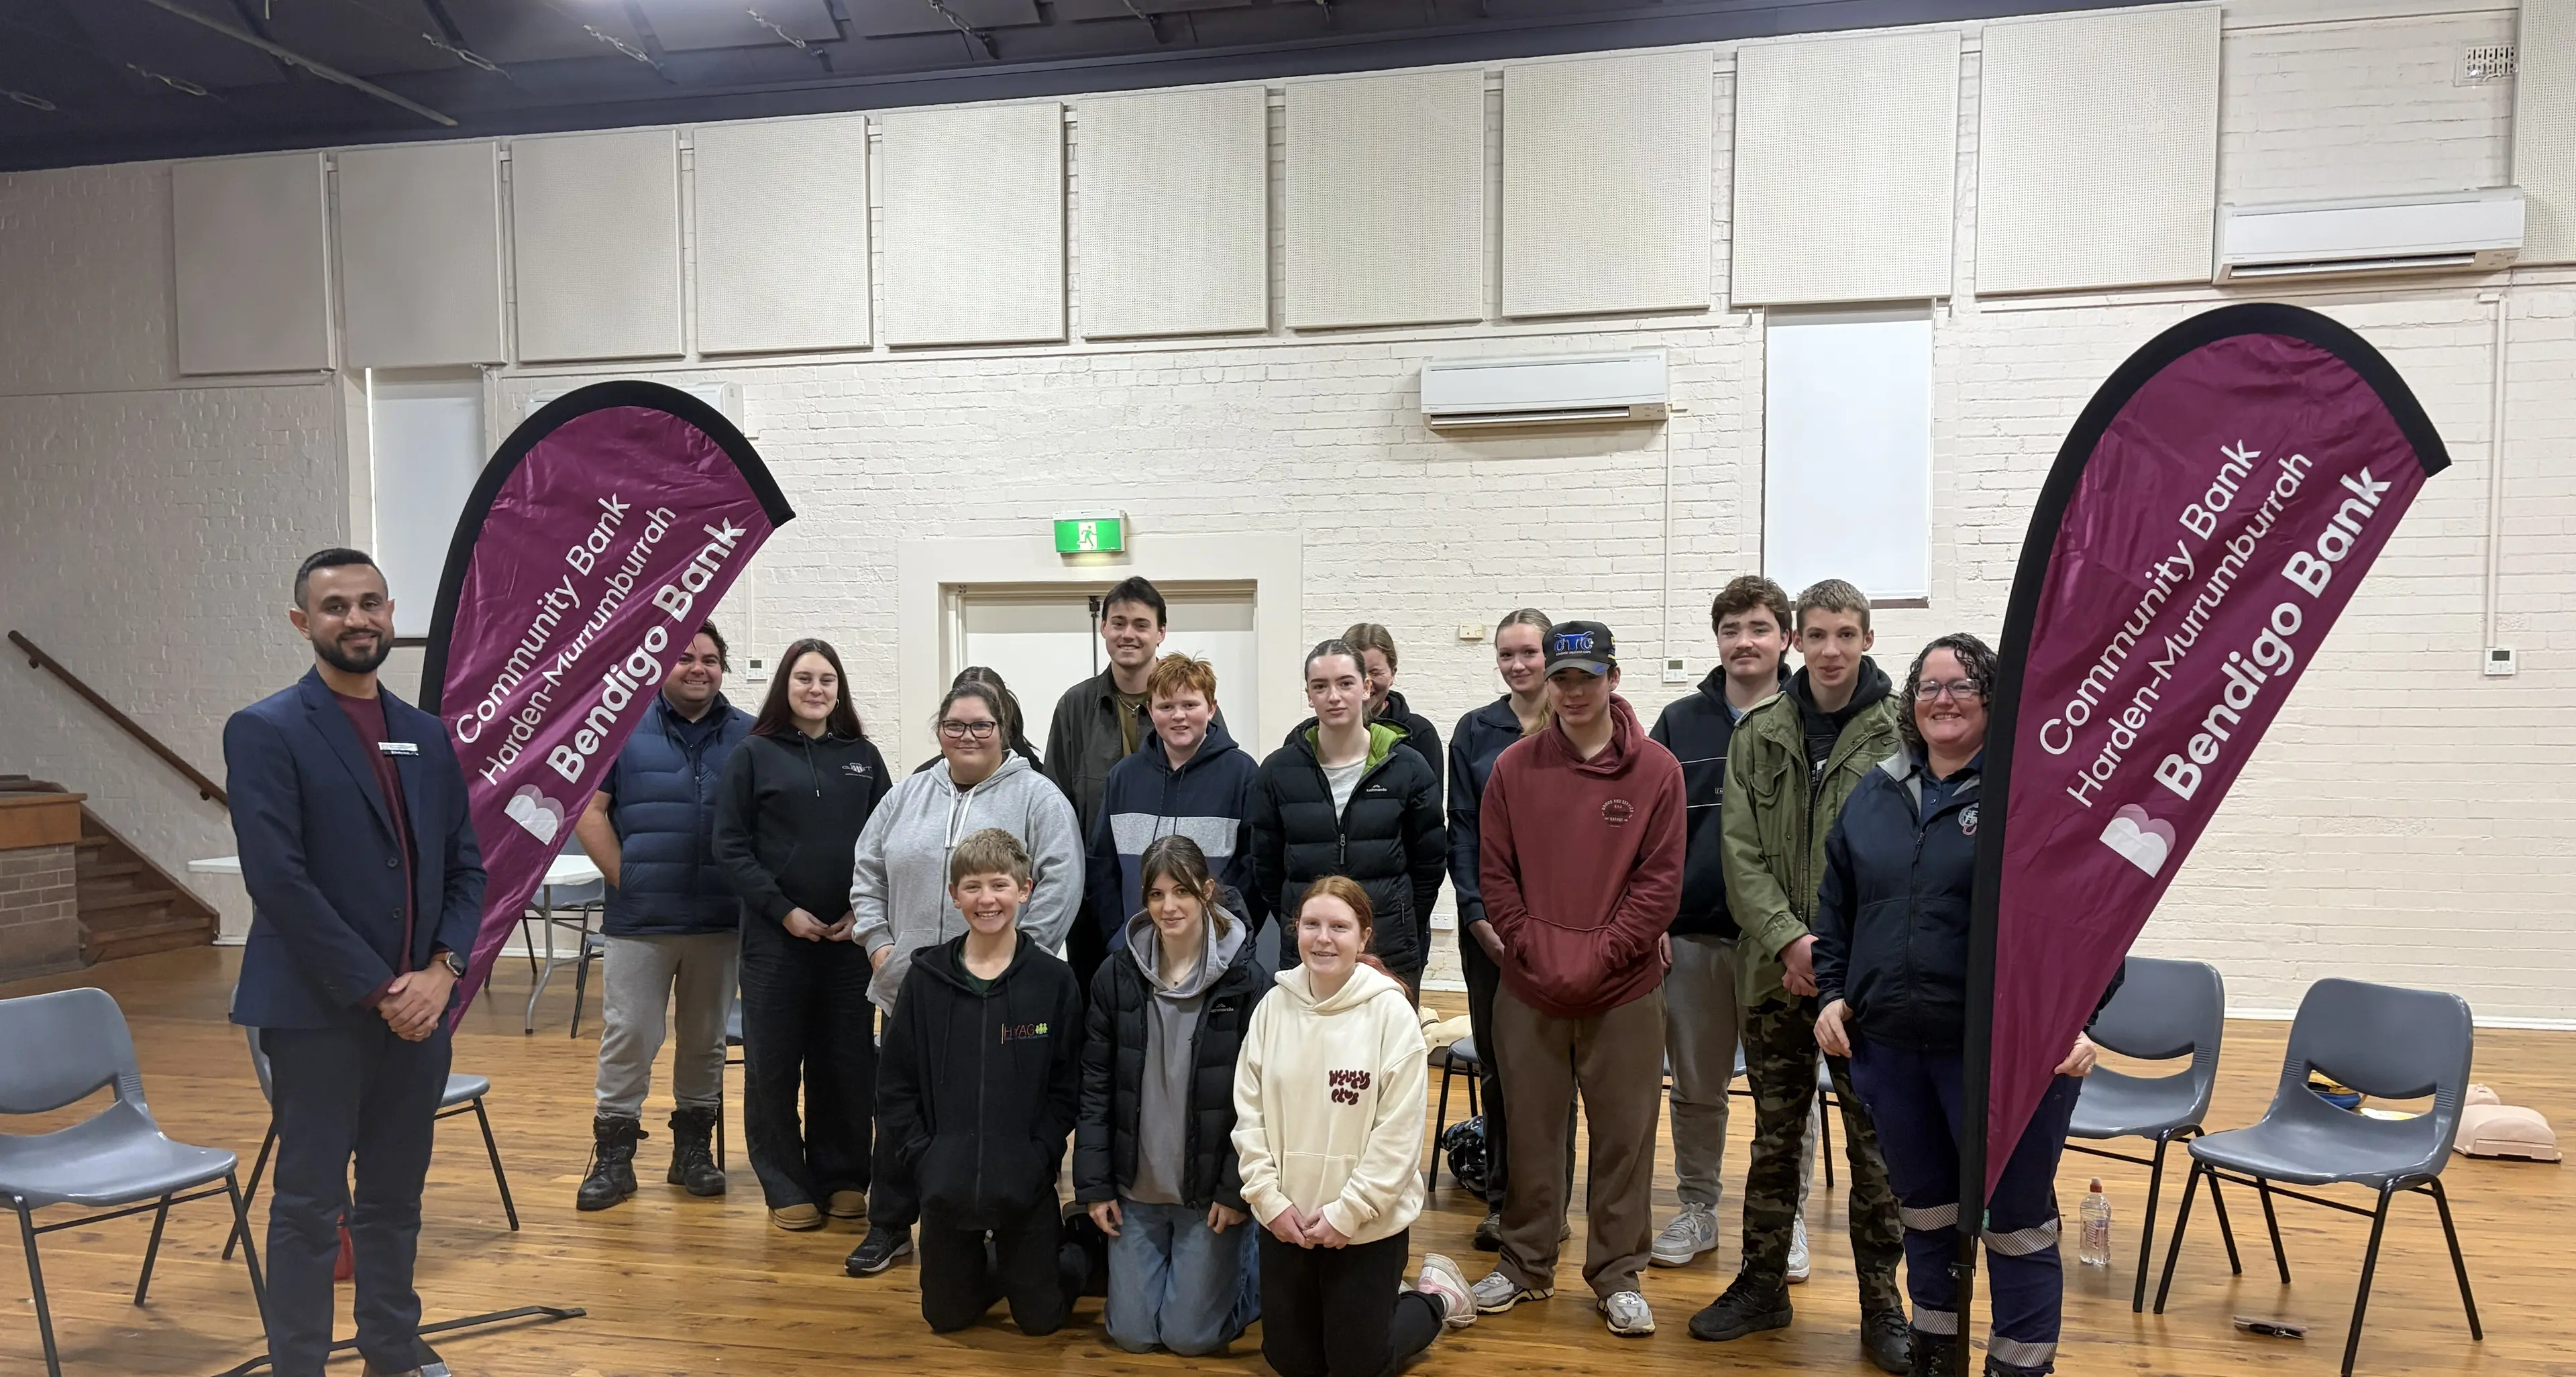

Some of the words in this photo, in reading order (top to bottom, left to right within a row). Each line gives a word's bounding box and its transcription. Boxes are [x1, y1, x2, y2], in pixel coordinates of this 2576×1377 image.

[456, 574, 580, 744] Community
[566, 492, 631, 577] Bank
[479, 507, 676, 786] Harden-Murrumburrah
[546, 625, 668, 784] Bendigo
[652, 516, 747, 622] Bank
[2040, 539, 2195, 755] Community
[2179, 439, 2261, 541] Bank
[2067, 453, 2313, 808] Harden-Murrumburrah
[2153, 602, 2302, 801] Bendigo
[2282, 466, 2392, 598] Bank
[1004, 1024, 1035, 1038] HYAG
